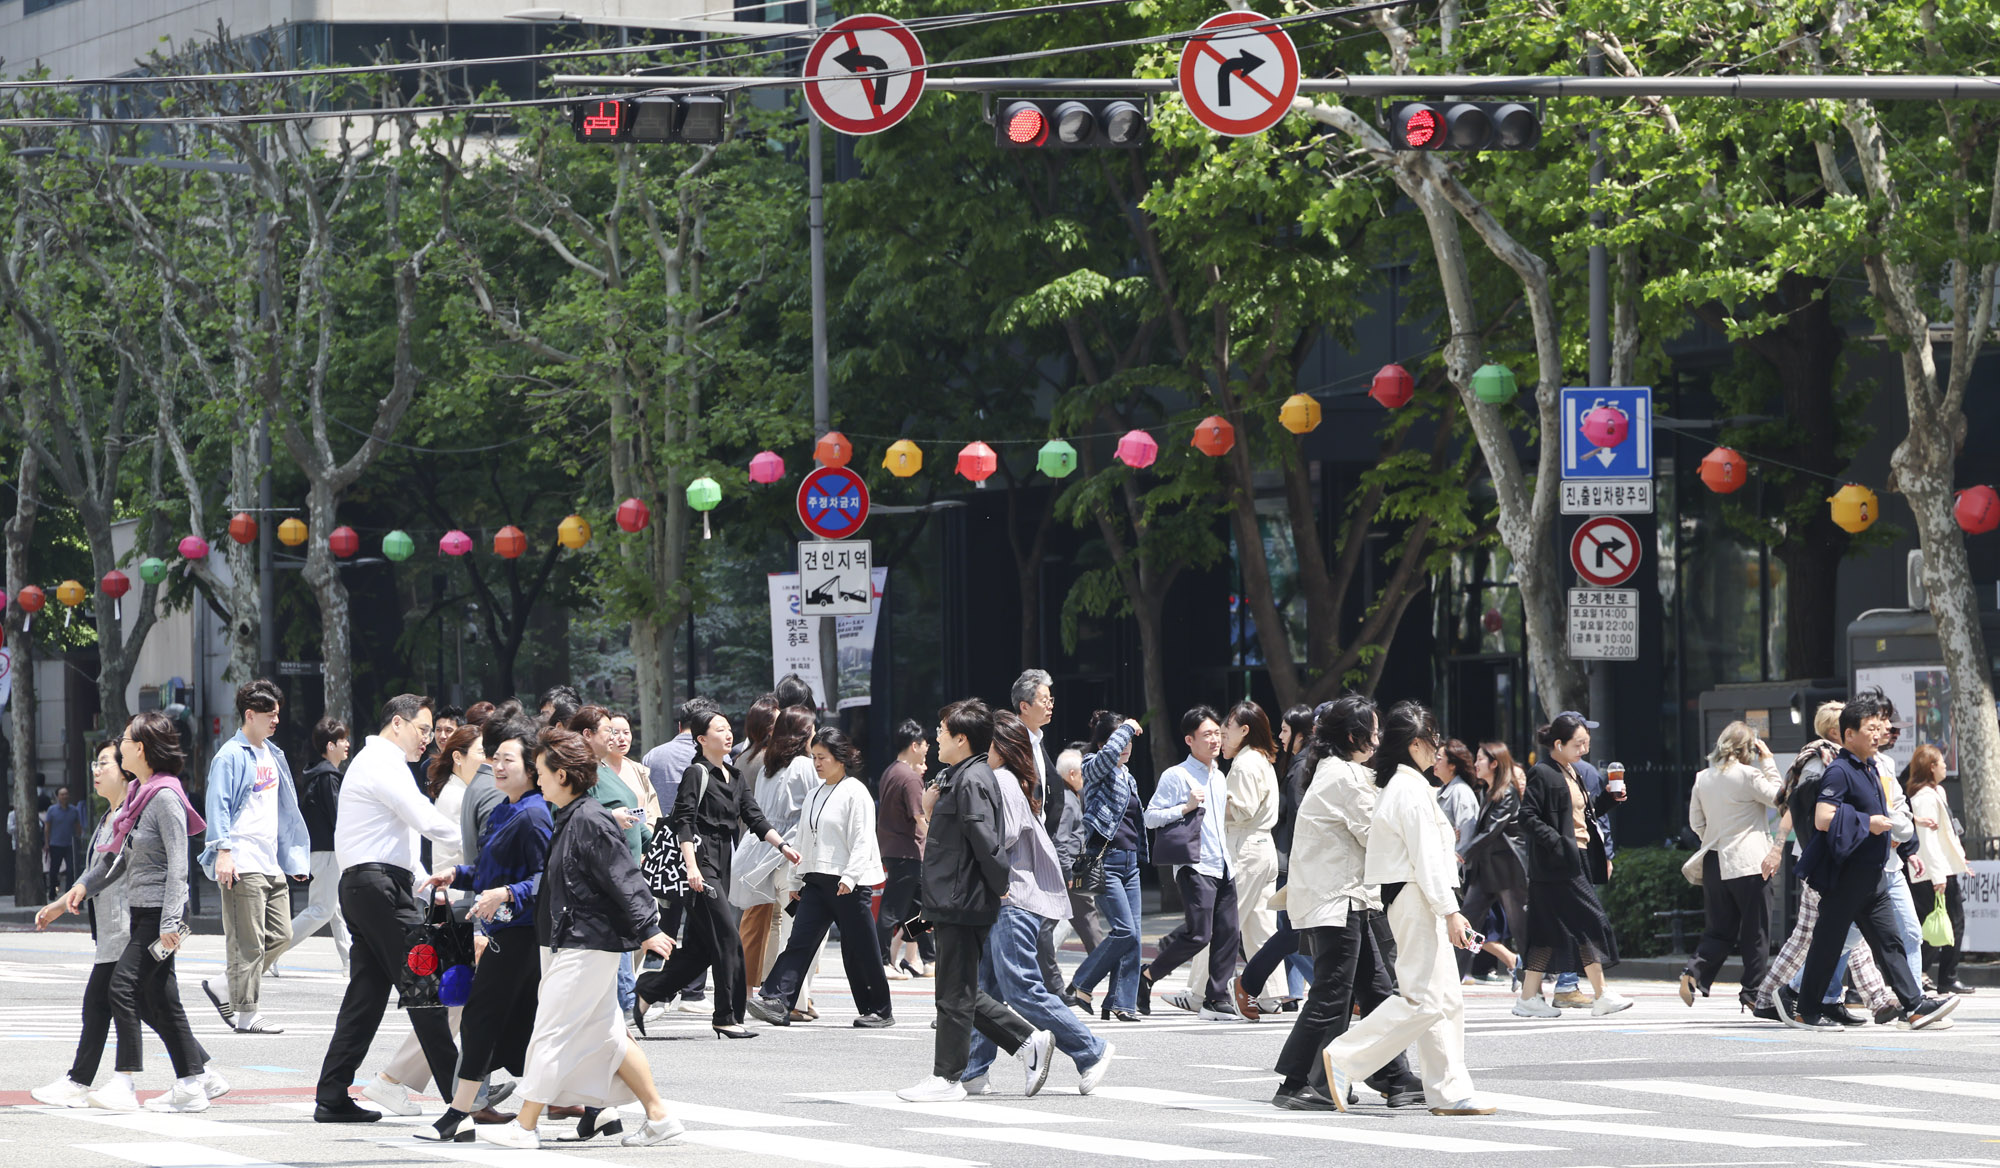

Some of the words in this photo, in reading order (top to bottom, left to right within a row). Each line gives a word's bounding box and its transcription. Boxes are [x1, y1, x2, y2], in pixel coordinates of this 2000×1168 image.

[807, 496, 860, 509] 주정차금지
[1566, 486, 1648, 507] 진,출입차량주의
[804, 550, 868, 570] 견인지역
[1577, 592, 1629, 605] 청계천로
[1573, 608, 1597, 618] 토요일
[1600, 608, 1627, 619] 14:00
[786, 619, 808, 632] 렛츠
[1606, 620, 1634, 631] 22:00
[787, 633, 809, 647] 종로
[1605, 633, 1632, 644] 10:00
[256, 766, 273, 780] NIKE
